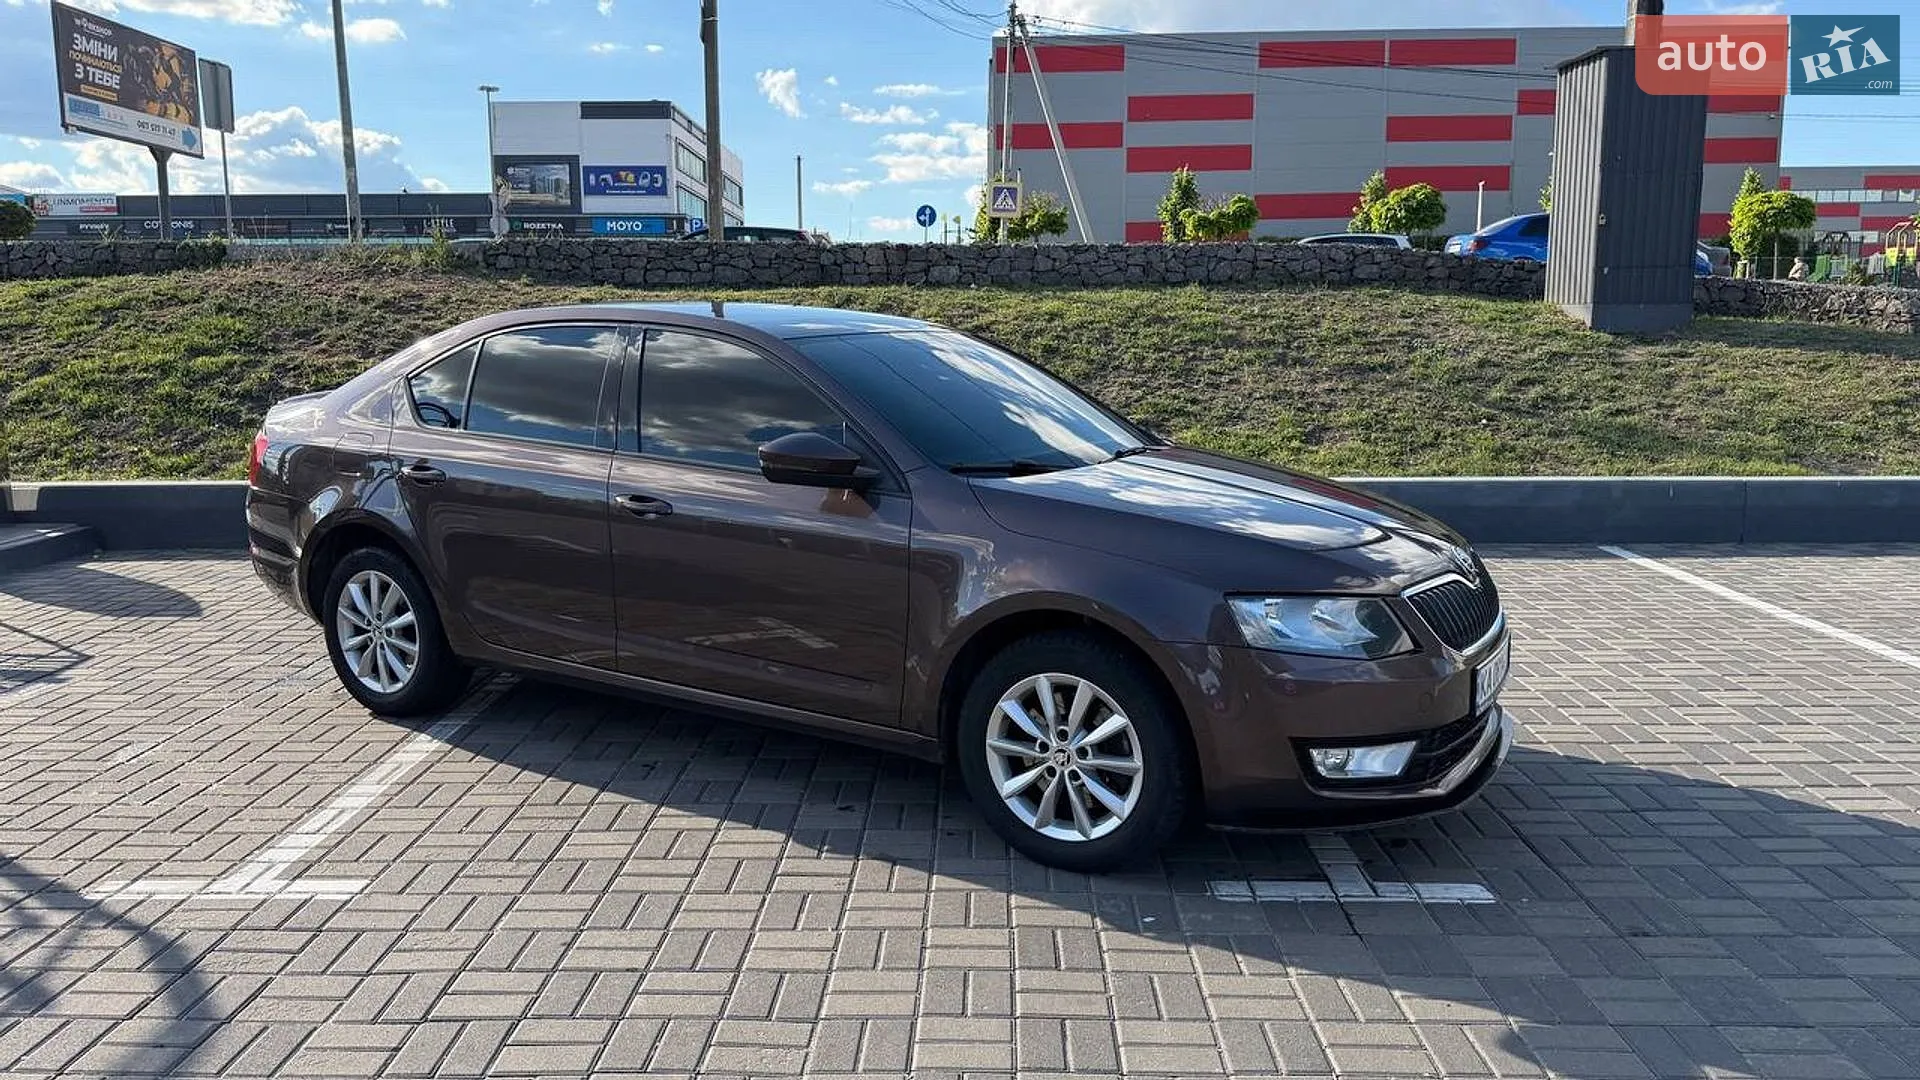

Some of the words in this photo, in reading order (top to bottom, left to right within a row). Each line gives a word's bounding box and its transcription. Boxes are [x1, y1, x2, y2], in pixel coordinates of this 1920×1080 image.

[73, 33, 118, 62] ЗМІНИ
[87, 66, 120, 89] ТЕБЕ
[606, 221, 642, 231] MOYO
[692, 221, 701, 232] P
